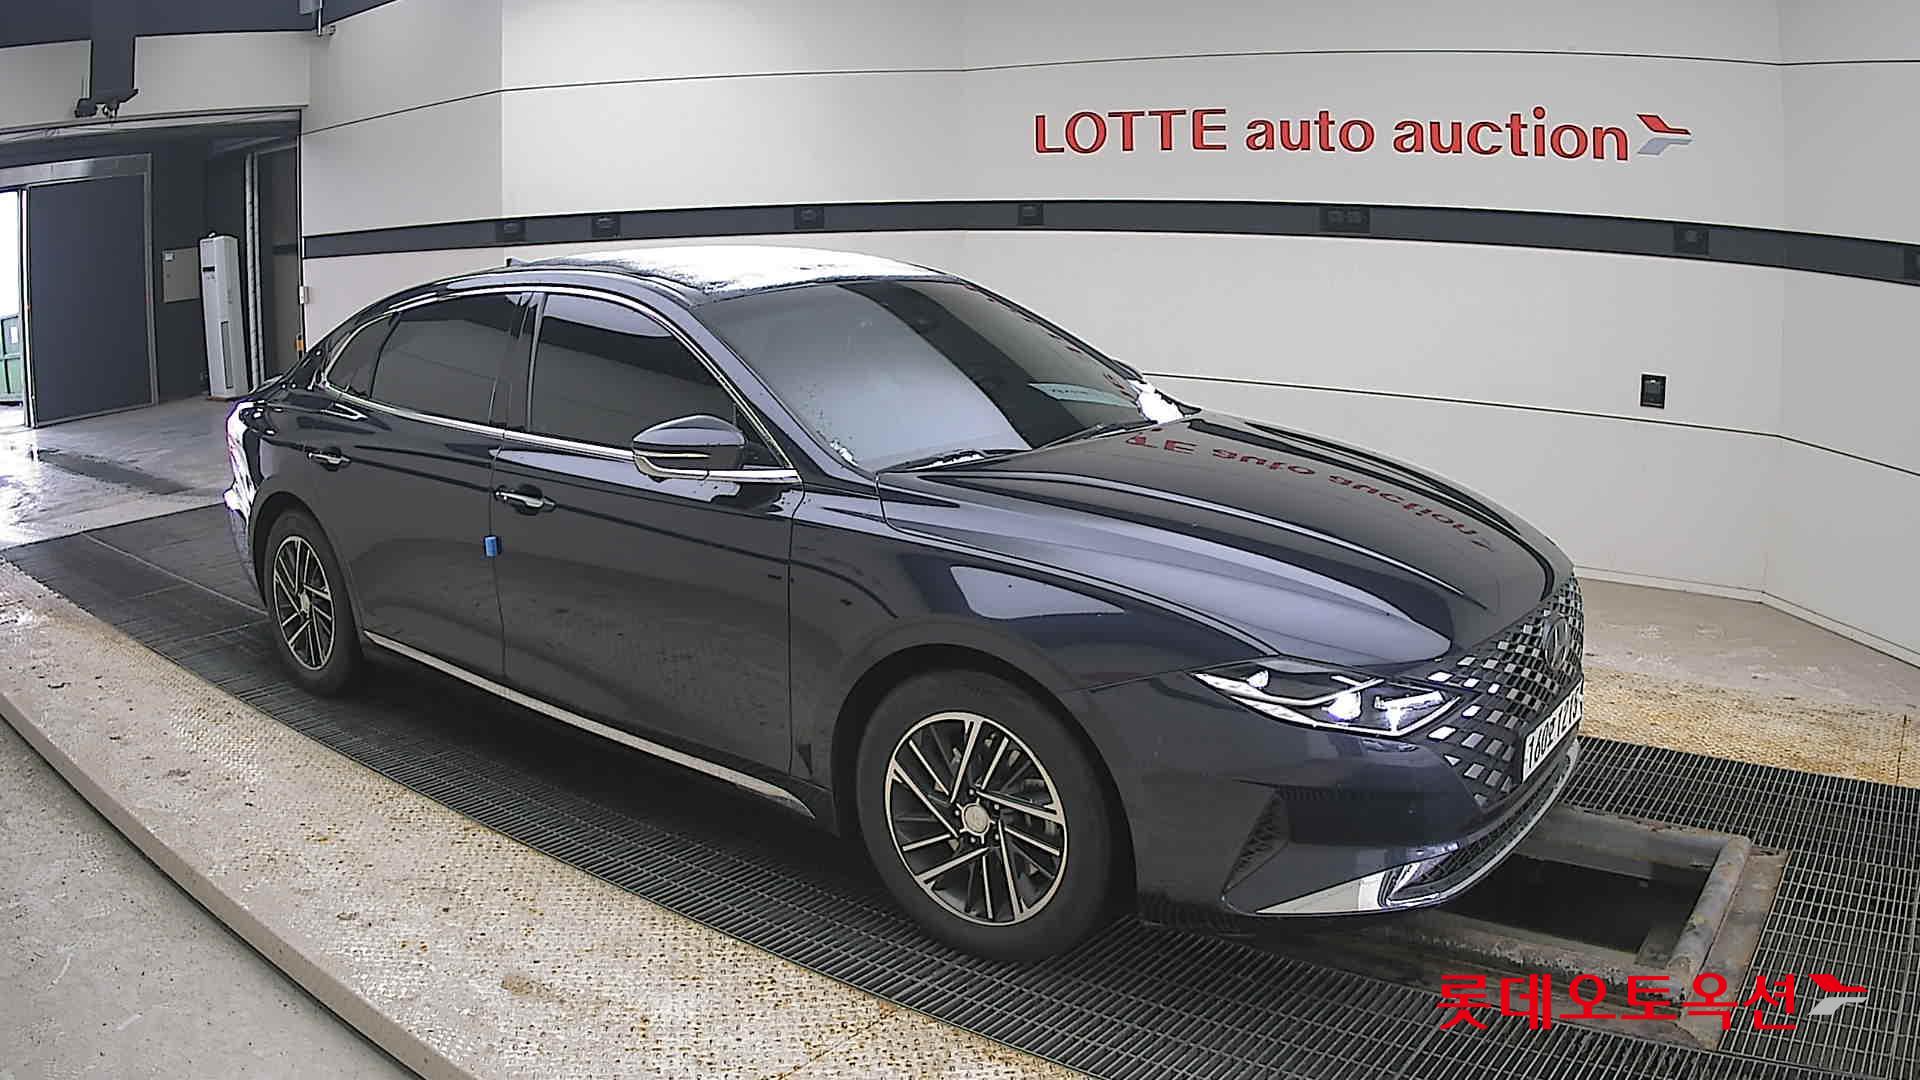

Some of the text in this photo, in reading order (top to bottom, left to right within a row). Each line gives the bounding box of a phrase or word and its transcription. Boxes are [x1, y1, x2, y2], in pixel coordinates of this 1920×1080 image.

[1036, 106, 1628, 161] LOTTE auto auction
